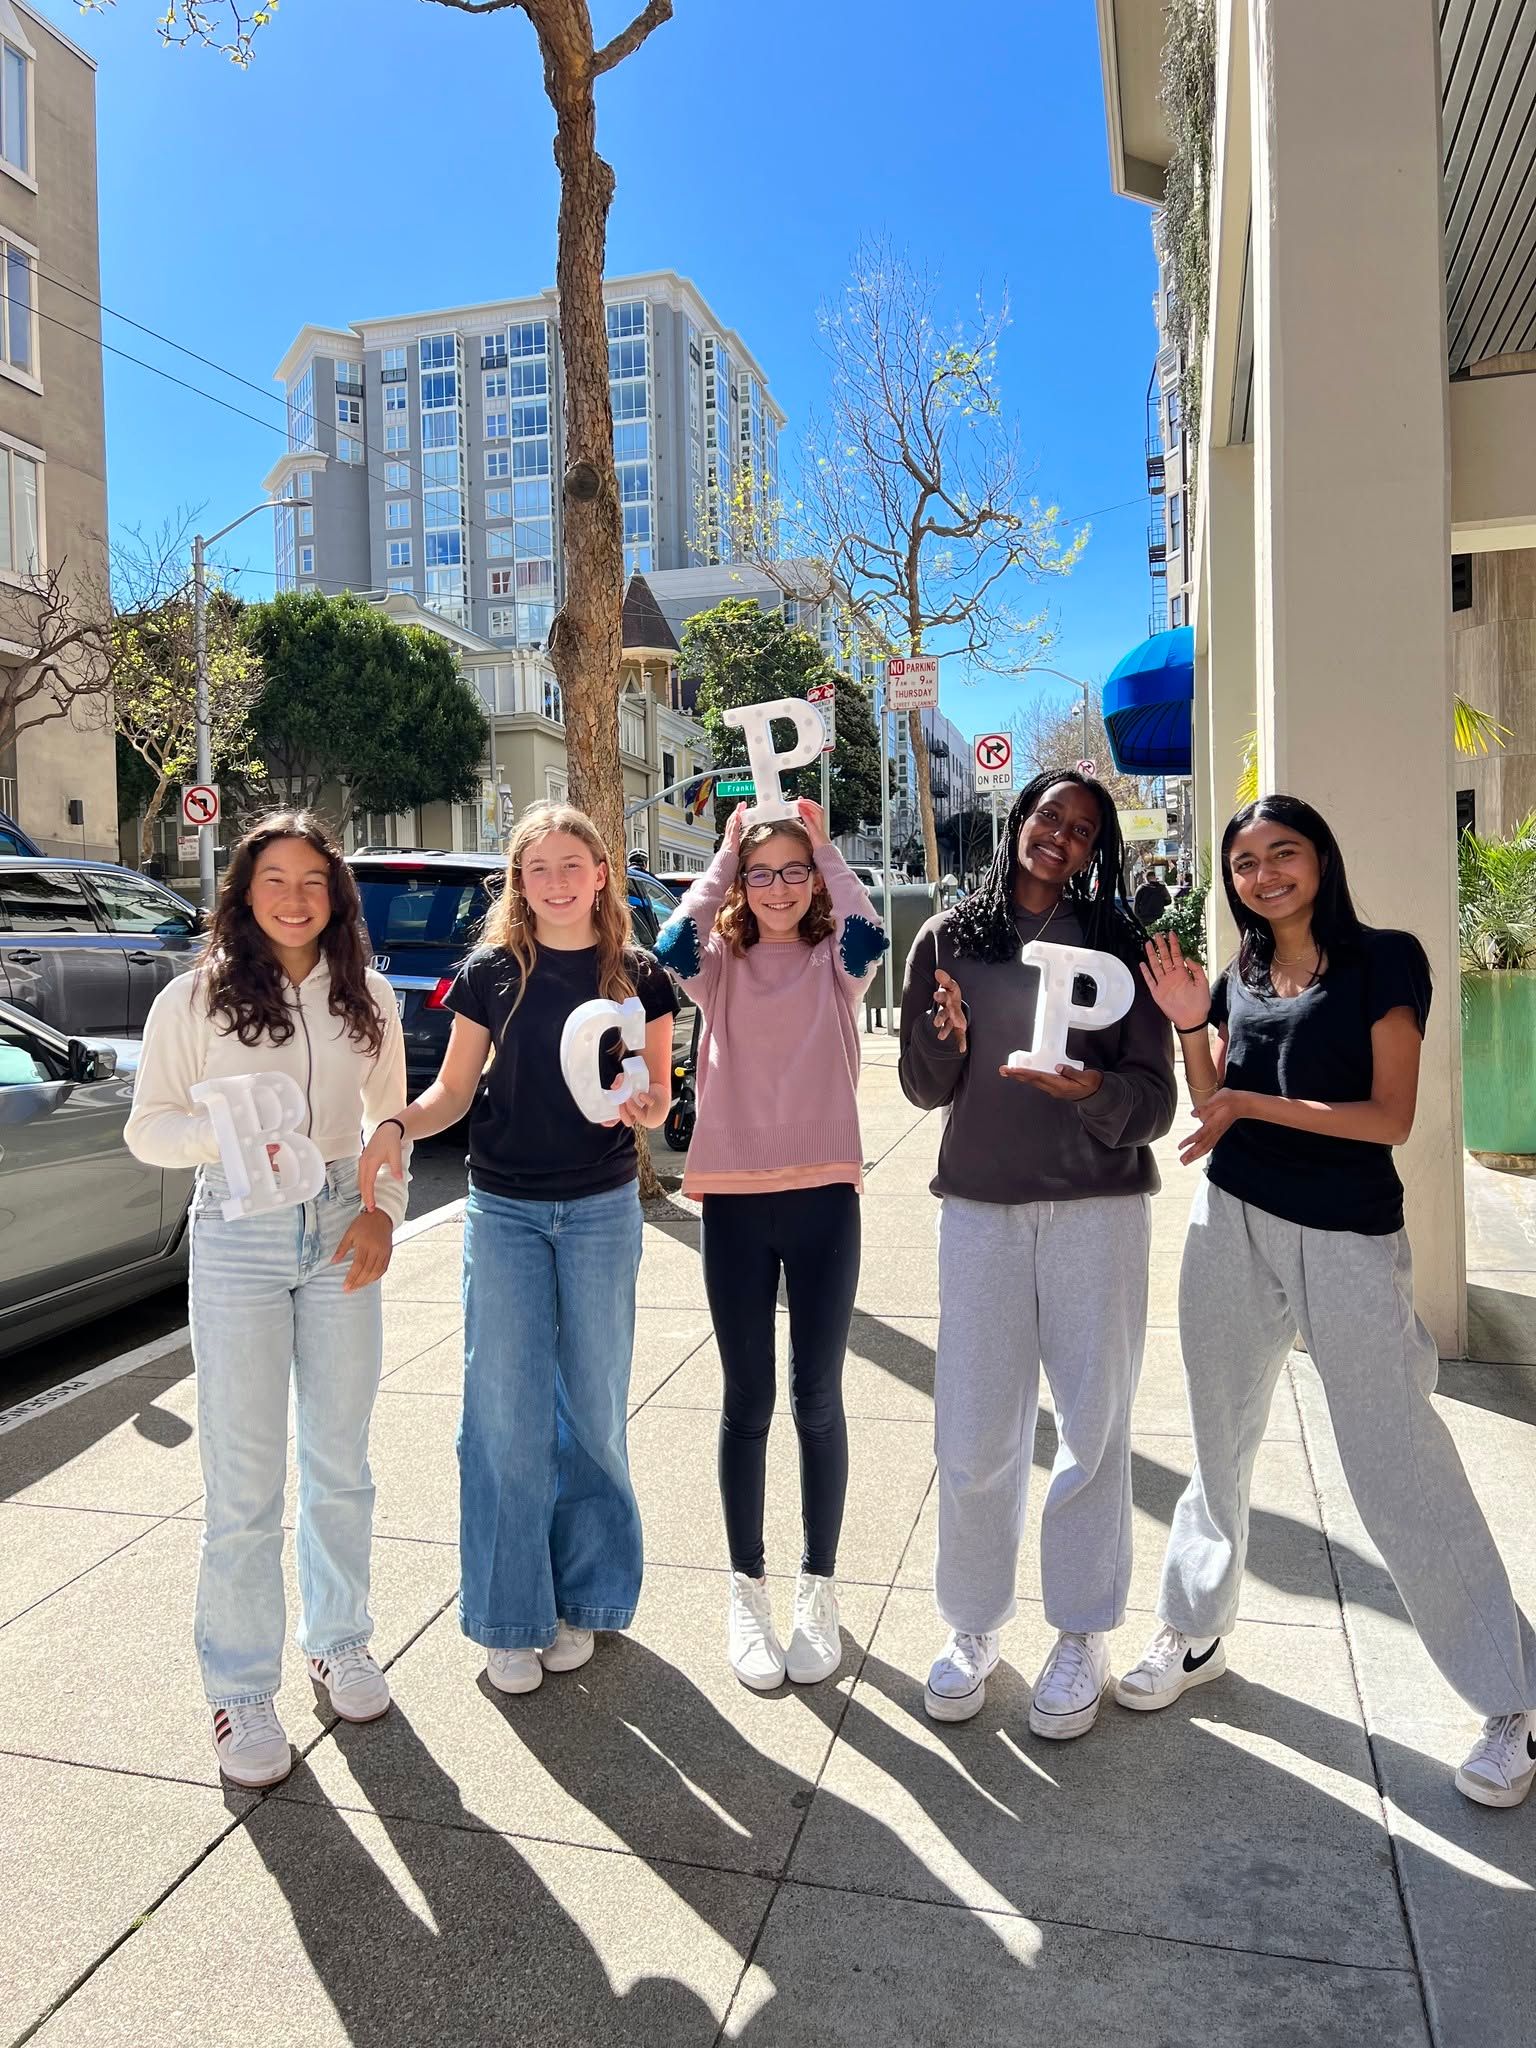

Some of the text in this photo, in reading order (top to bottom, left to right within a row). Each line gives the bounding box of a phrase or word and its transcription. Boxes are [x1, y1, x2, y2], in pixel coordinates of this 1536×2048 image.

[890, 661, 936, 674] NO PARKING
[895, 688, 932, 698] THURSDAY
[723, 697, 826, 825] P
[977, 773, 1010, 785] ON RED
[727, 784, 755, 793] Frankli
[1008, 940, 1136, 1074] P
[190, 1071, 326, 1223] B
